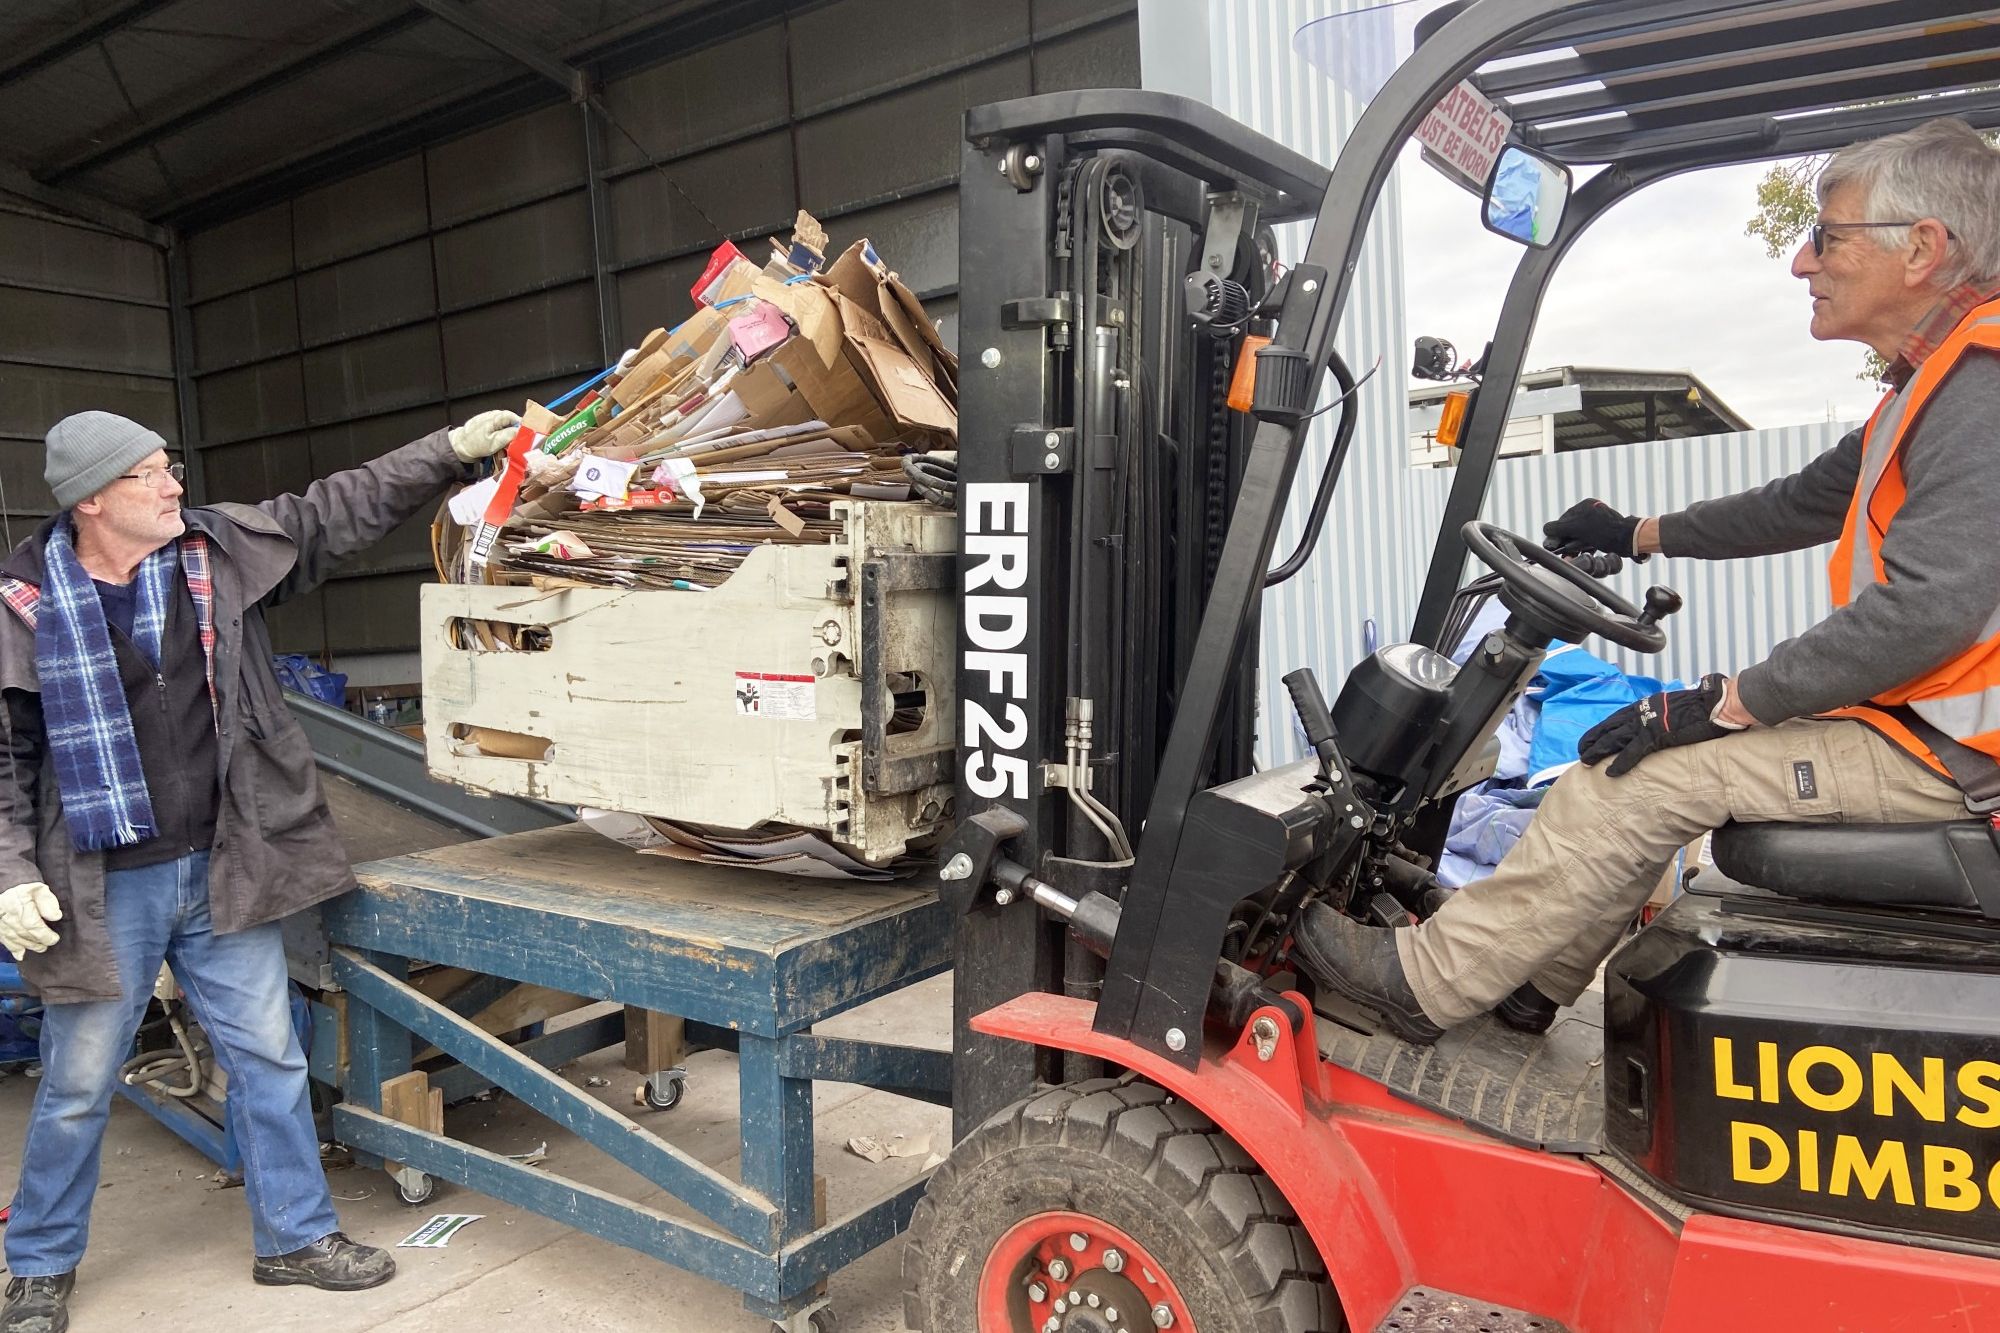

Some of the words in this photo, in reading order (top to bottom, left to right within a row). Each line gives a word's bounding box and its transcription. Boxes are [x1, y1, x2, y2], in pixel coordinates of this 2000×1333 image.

[1418, 113, 1448, 146] UST
[1443, 130, 1462, 160] BE
[1458, 141, 1490, 180] WORN
[965, 483, 1029, 800] ERDF25
[1713, 1037, 2000, 1129] LIONS
[1731, 1121, 2000, 1213] DIMB
